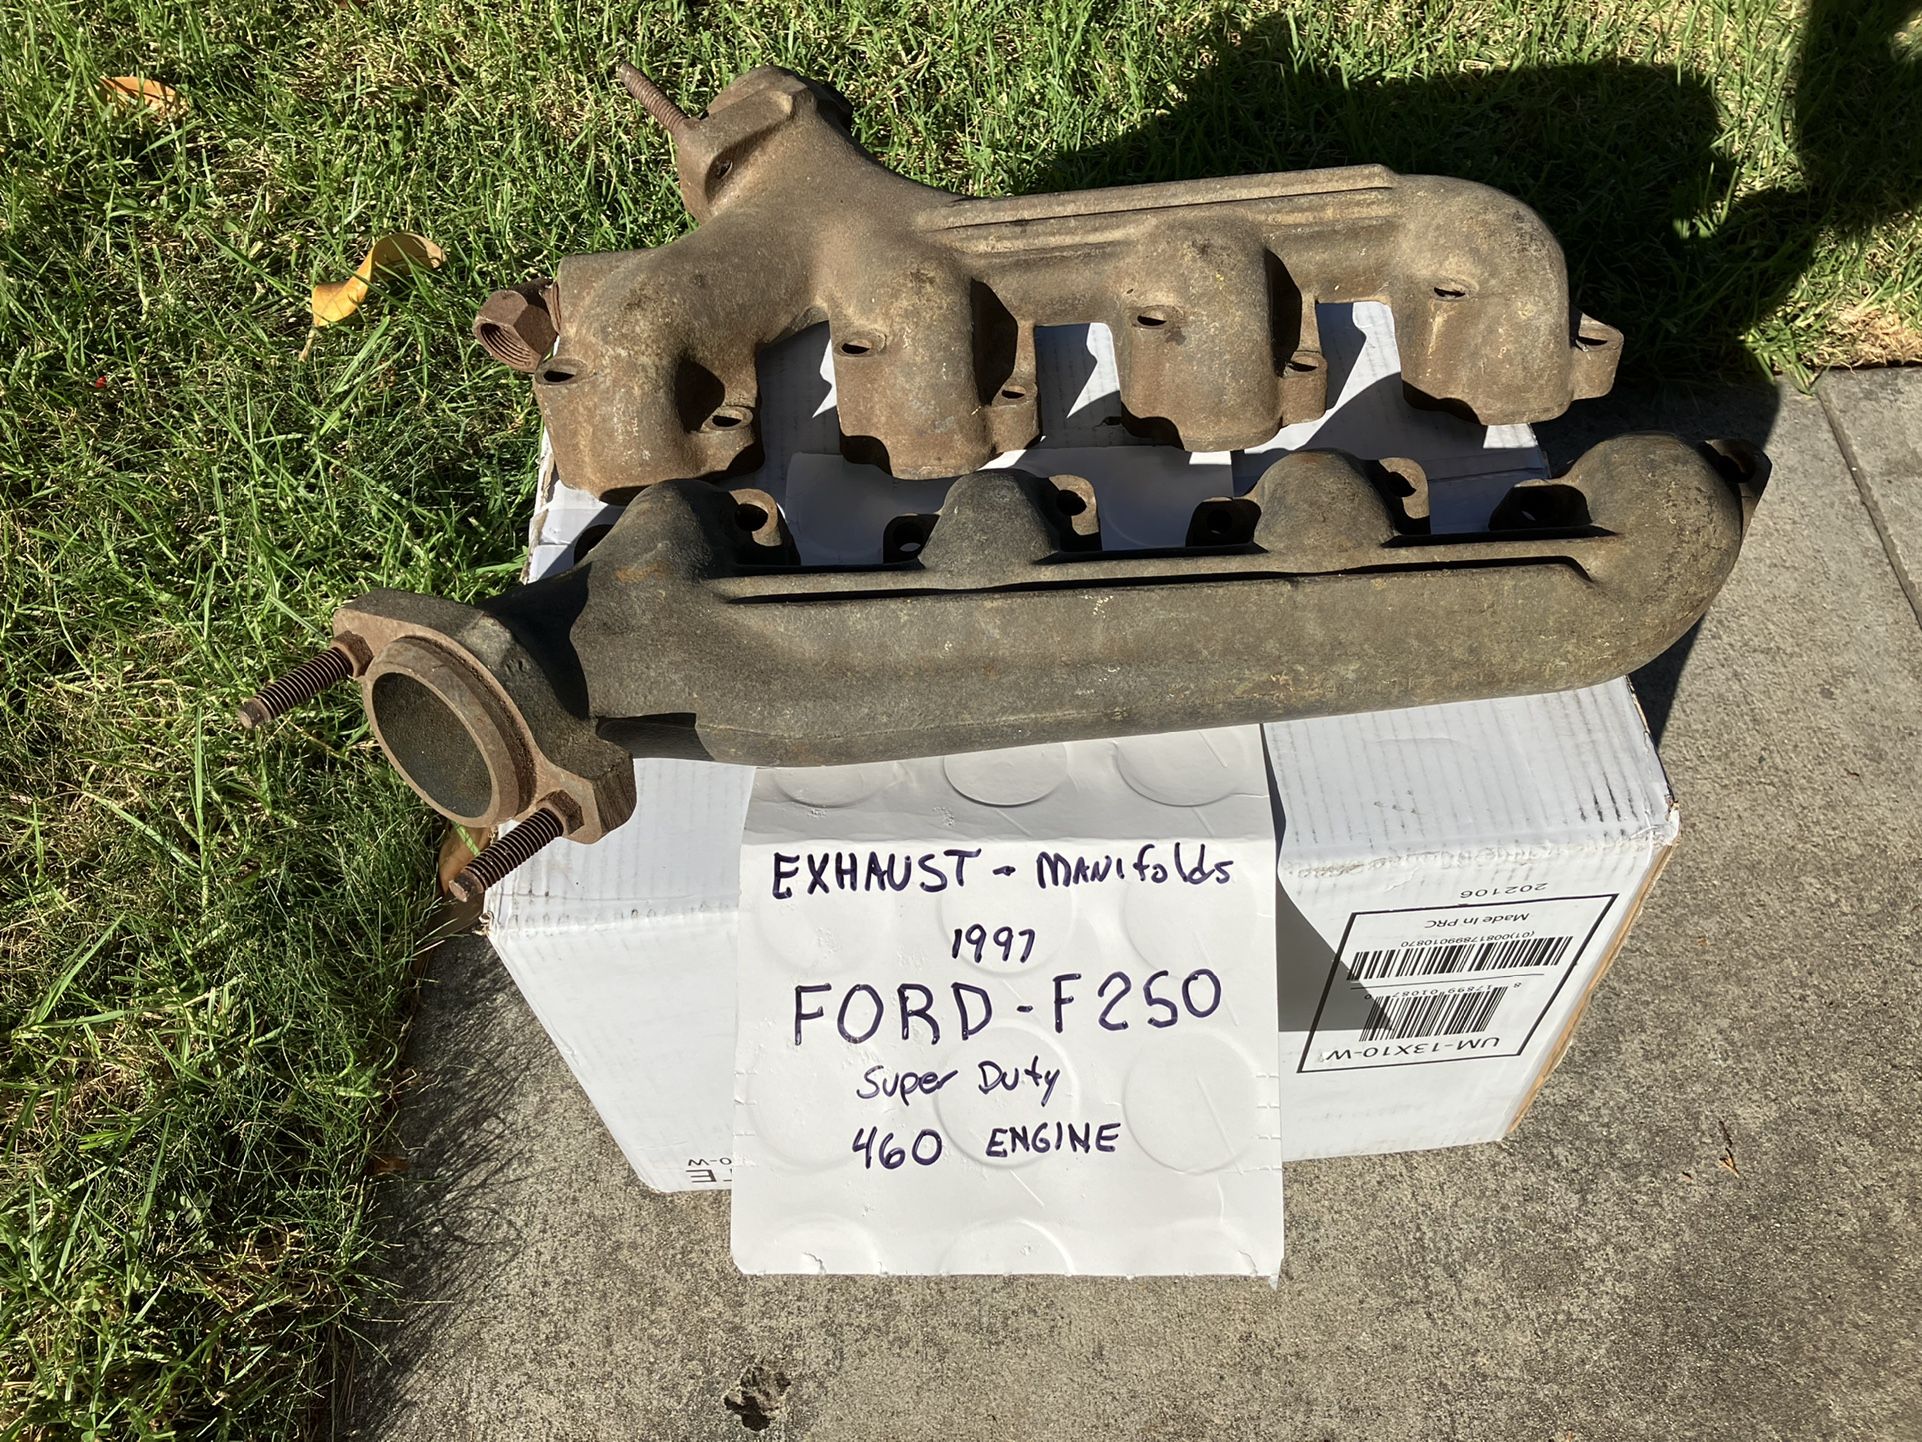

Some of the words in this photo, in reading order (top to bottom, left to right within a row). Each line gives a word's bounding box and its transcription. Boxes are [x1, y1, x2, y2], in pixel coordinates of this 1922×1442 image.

[772, 846, 983, 900] EXHAUST
[1459, 882, 1548, 899] 202106
[1424, 917, 1459, 929] PRC
[1482, 912, 1531, 924] Made
[951, 923, 1037, 964] 1997
[793, 981, 995, 1046] FORD
[1052, 967, 1223, 1034] F250
[1325, 1036, 1500, 1061] UM-13X10-W
[856, 1064, 960, 1106] Super
[978, 1056, 1061, 1107] Duty
[851, 1126, 943, 1170] 460
[985, 1122, 1121, 1158] ENGINE
